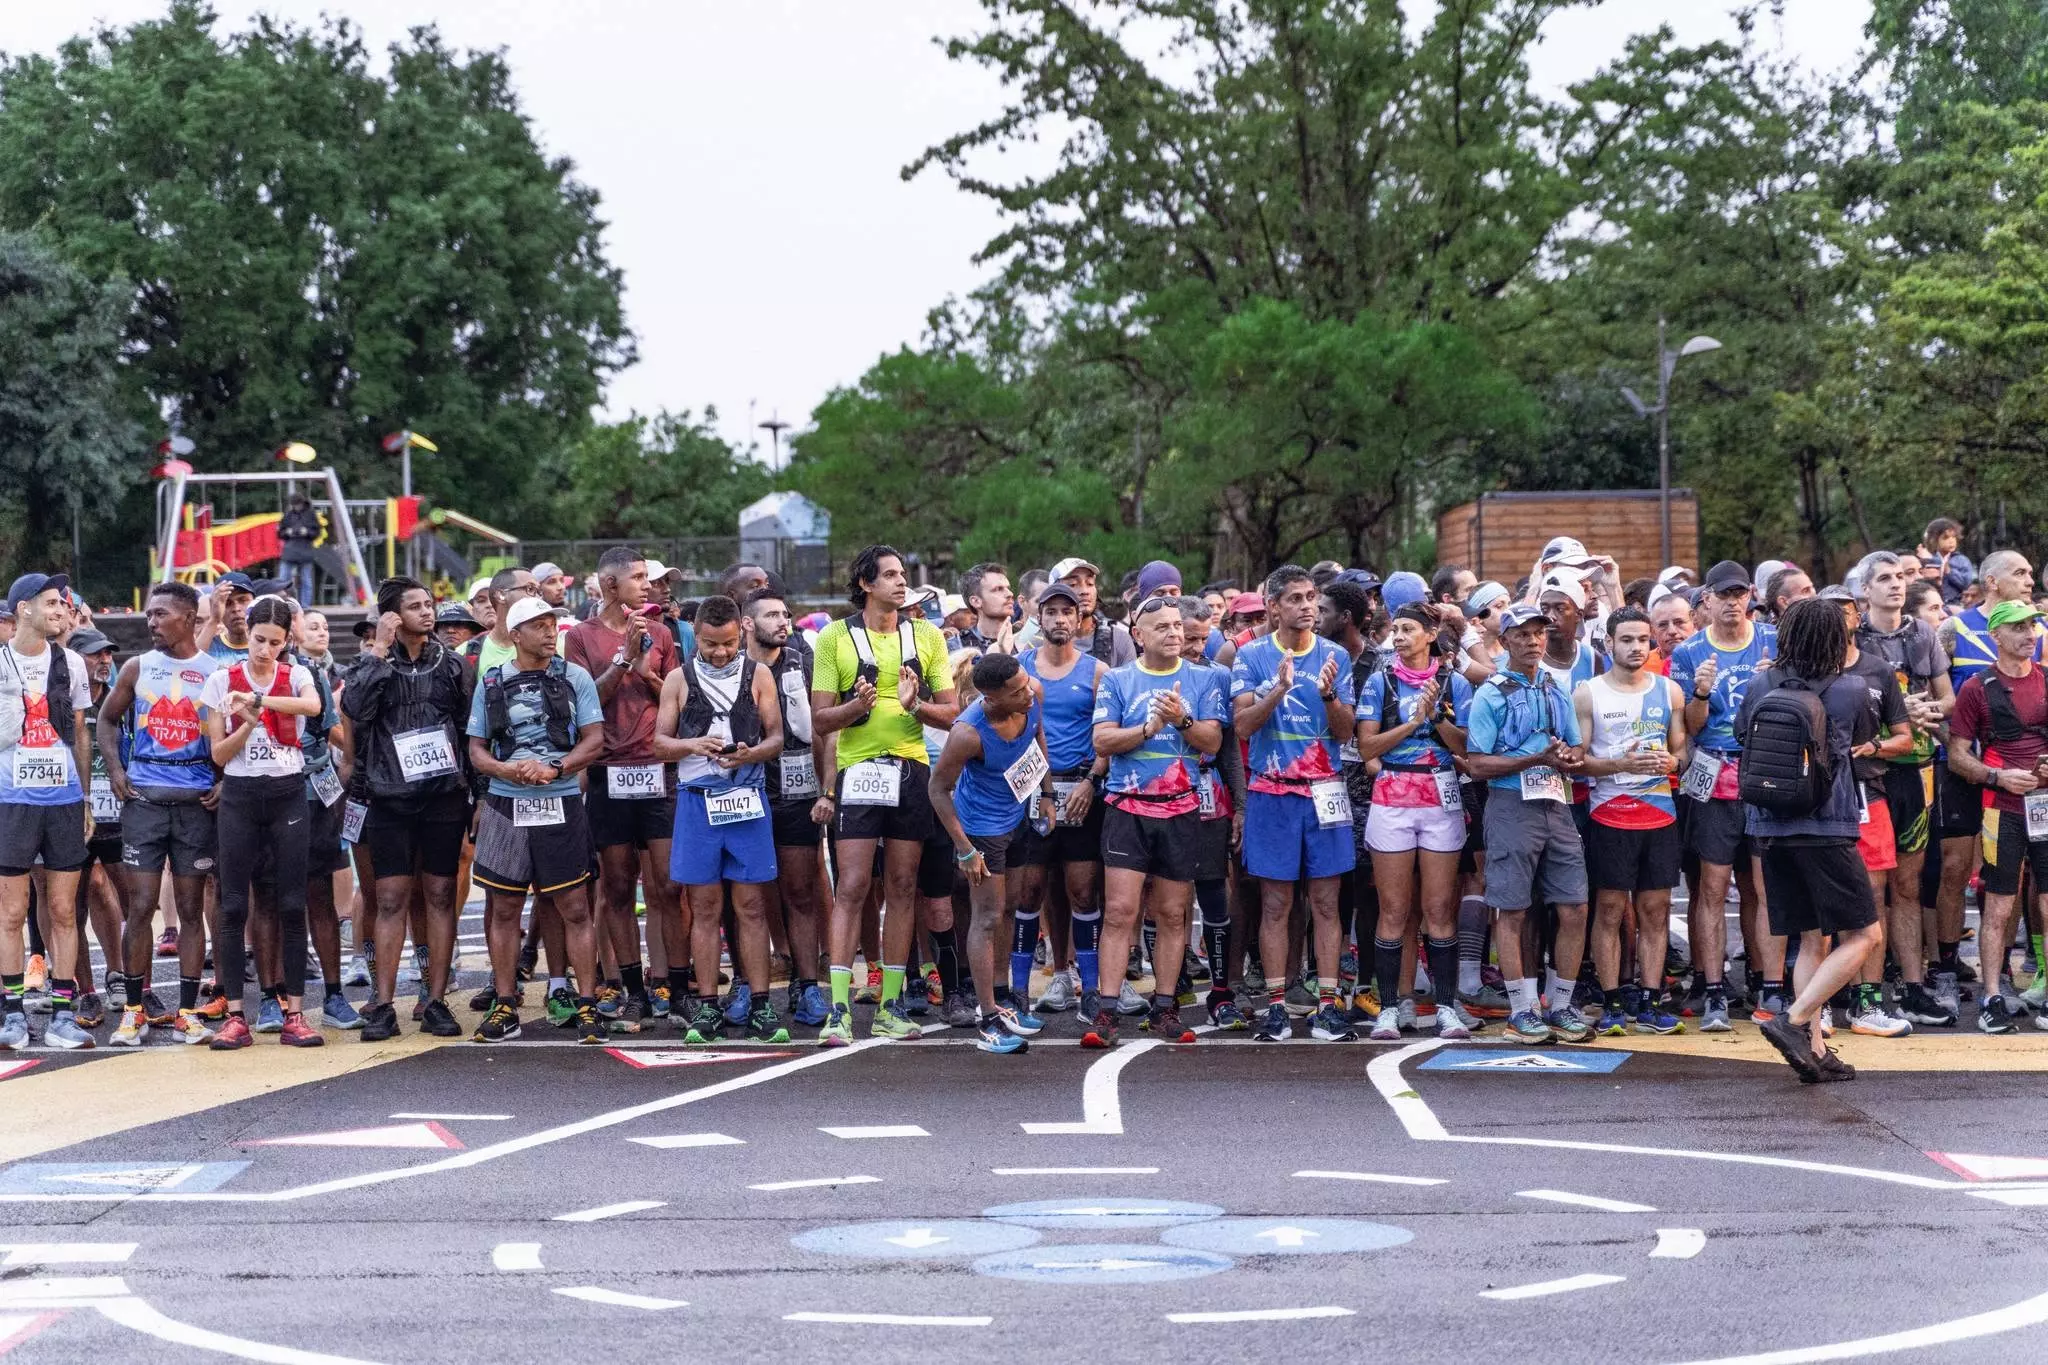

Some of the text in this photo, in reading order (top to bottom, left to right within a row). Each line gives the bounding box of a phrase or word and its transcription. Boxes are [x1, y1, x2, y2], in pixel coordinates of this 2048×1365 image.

[167, 718, 201, 730] PASSION
[152, 726, 190, 742] TRAIL
[404, 748, 448, 769] 60344
[19, 765, 62, 779] 57344
[616, 772, 655, 787] 9092
[852, 779, 890, 794] 5095
[517, 798, 557, 813] 62941
[716, 797, 750, 813] 70147
[1212, 928, 1227, 980] Kalenji
